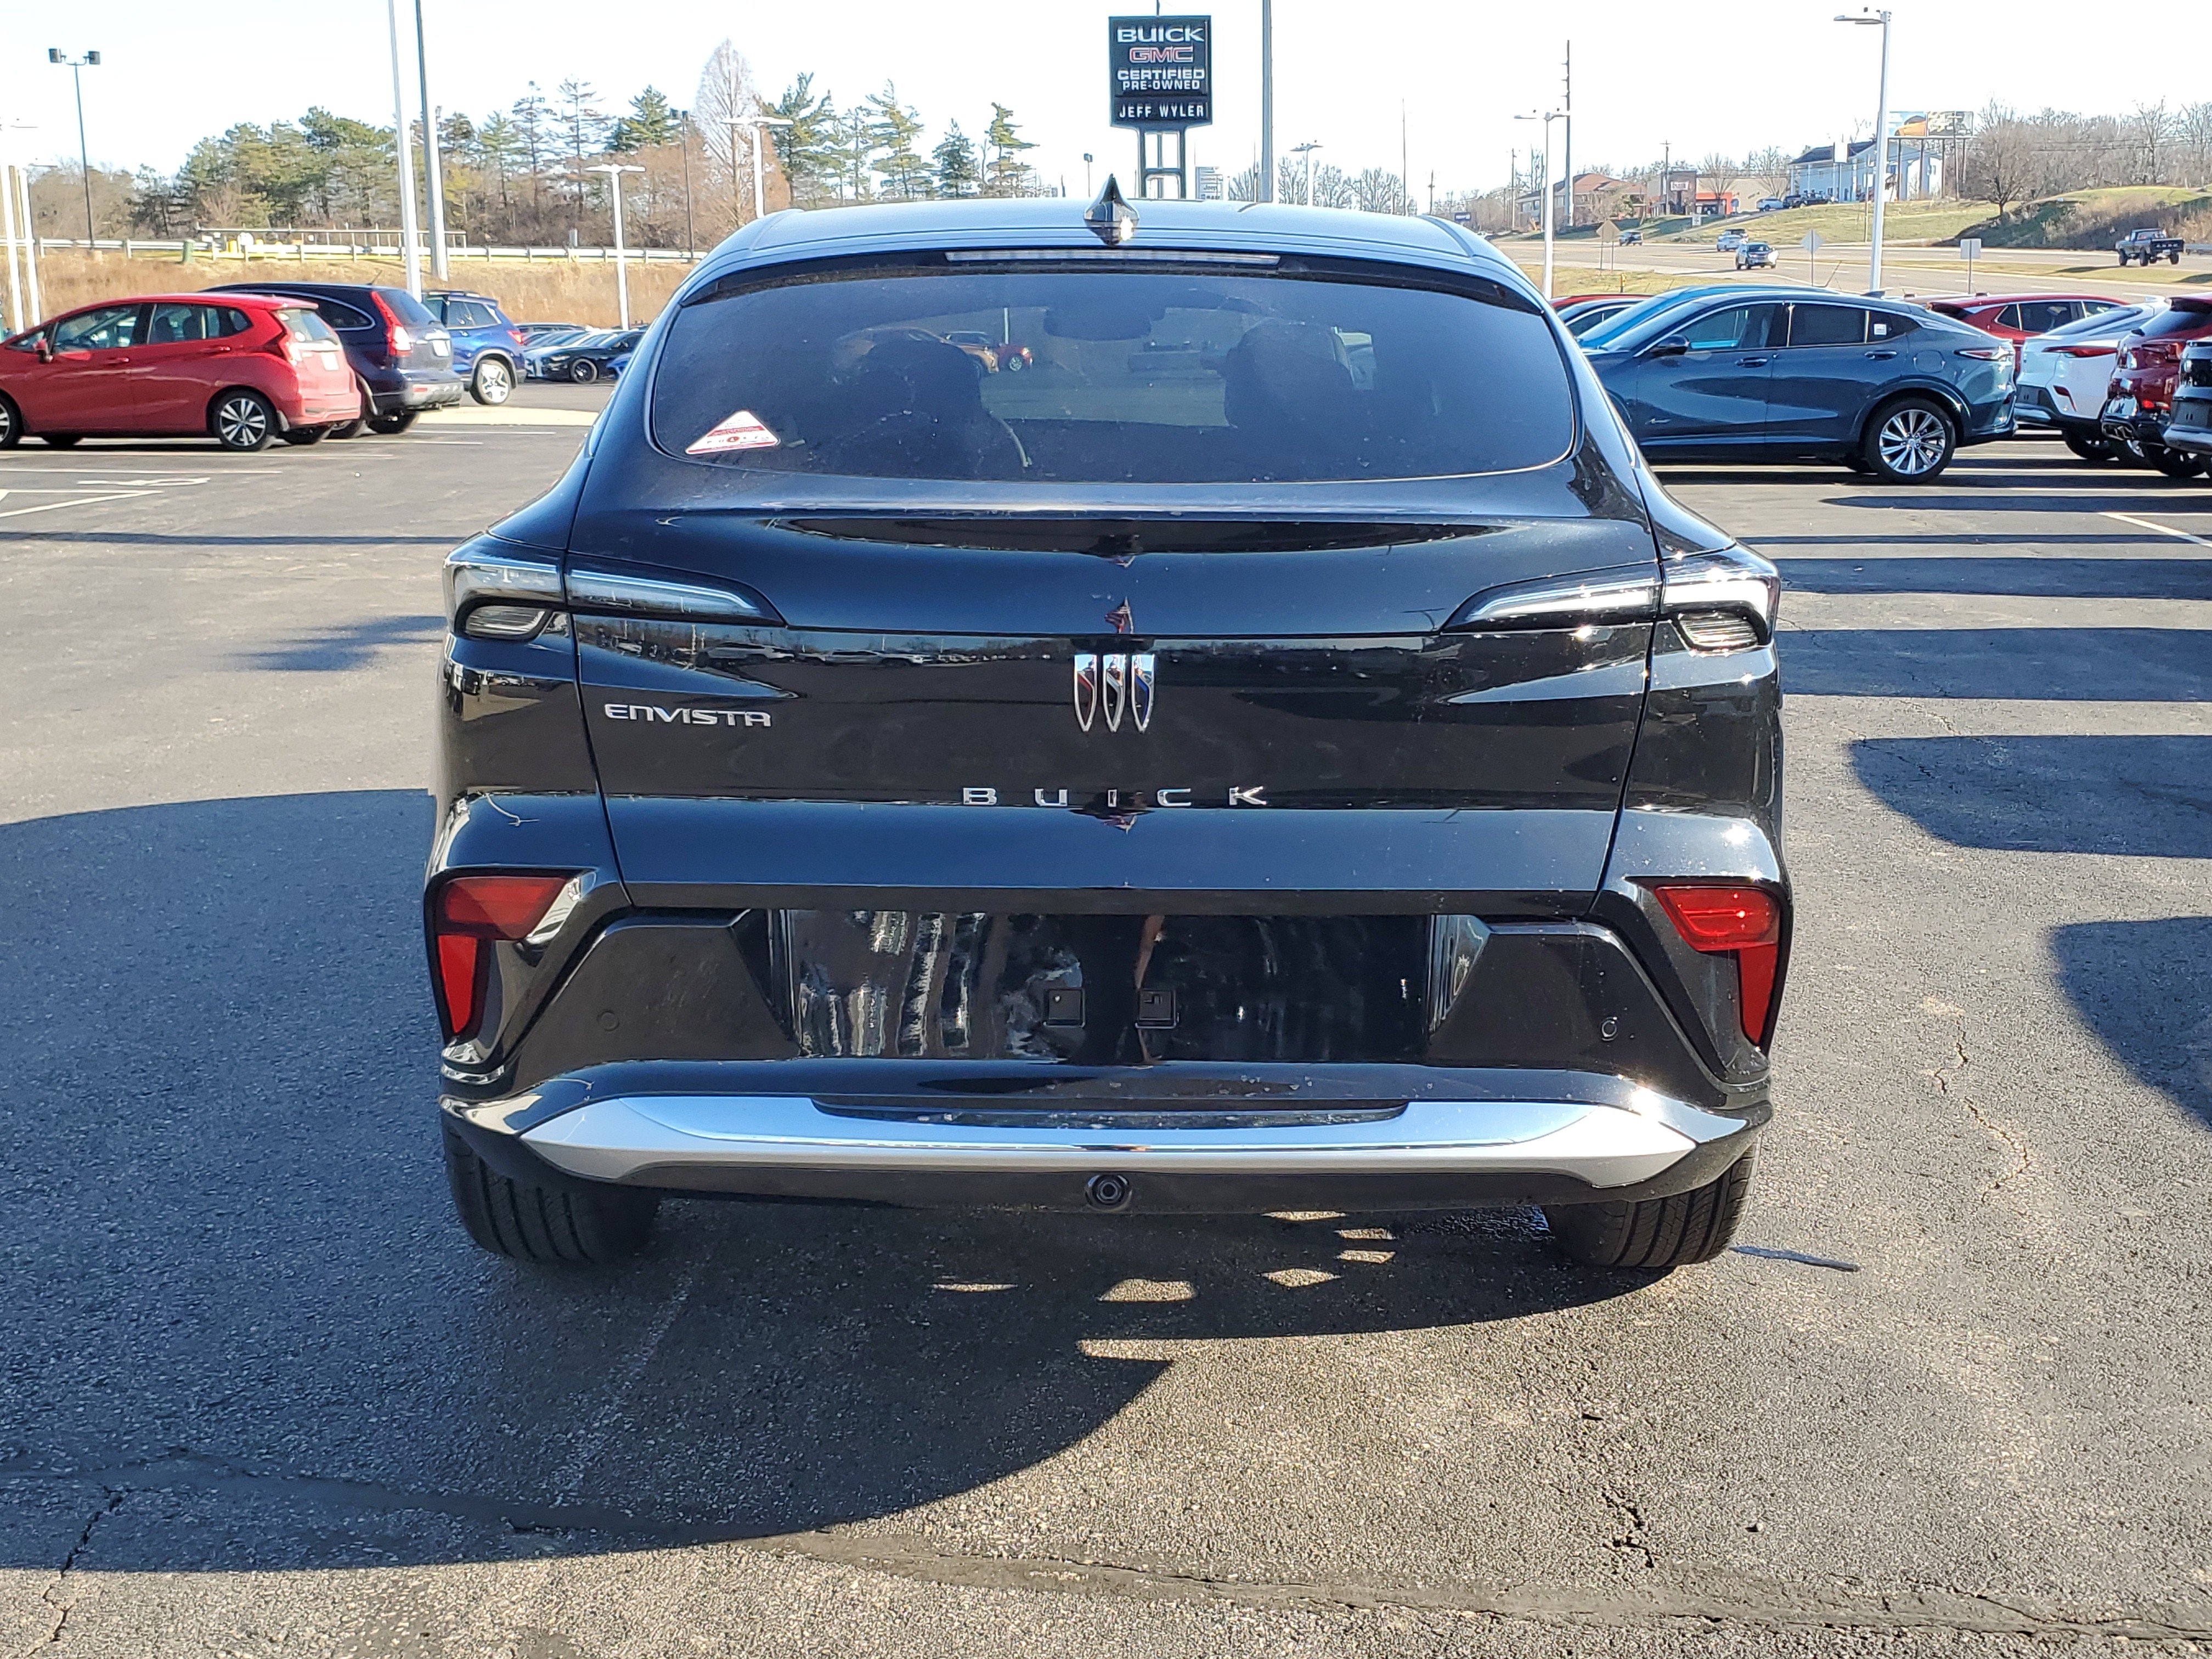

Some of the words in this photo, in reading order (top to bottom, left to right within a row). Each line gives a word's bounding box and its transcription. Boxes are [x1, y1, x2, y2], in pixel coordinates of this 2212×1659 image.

[1117, 27, 1205, 42] BUICK
[1129, 46, 1193, 63] GMC
[1117, 69, 1205, 81] CERTIFIED
[1122, 80, 1200, 90] PRE-OWNED
[1119, 105, 1152, 118] JEFF
[1159, 104, 1204, 117] WYLER
[605, 704, 771, 727] ENVISTA
[963, 786, 1266, 807] BUICK
